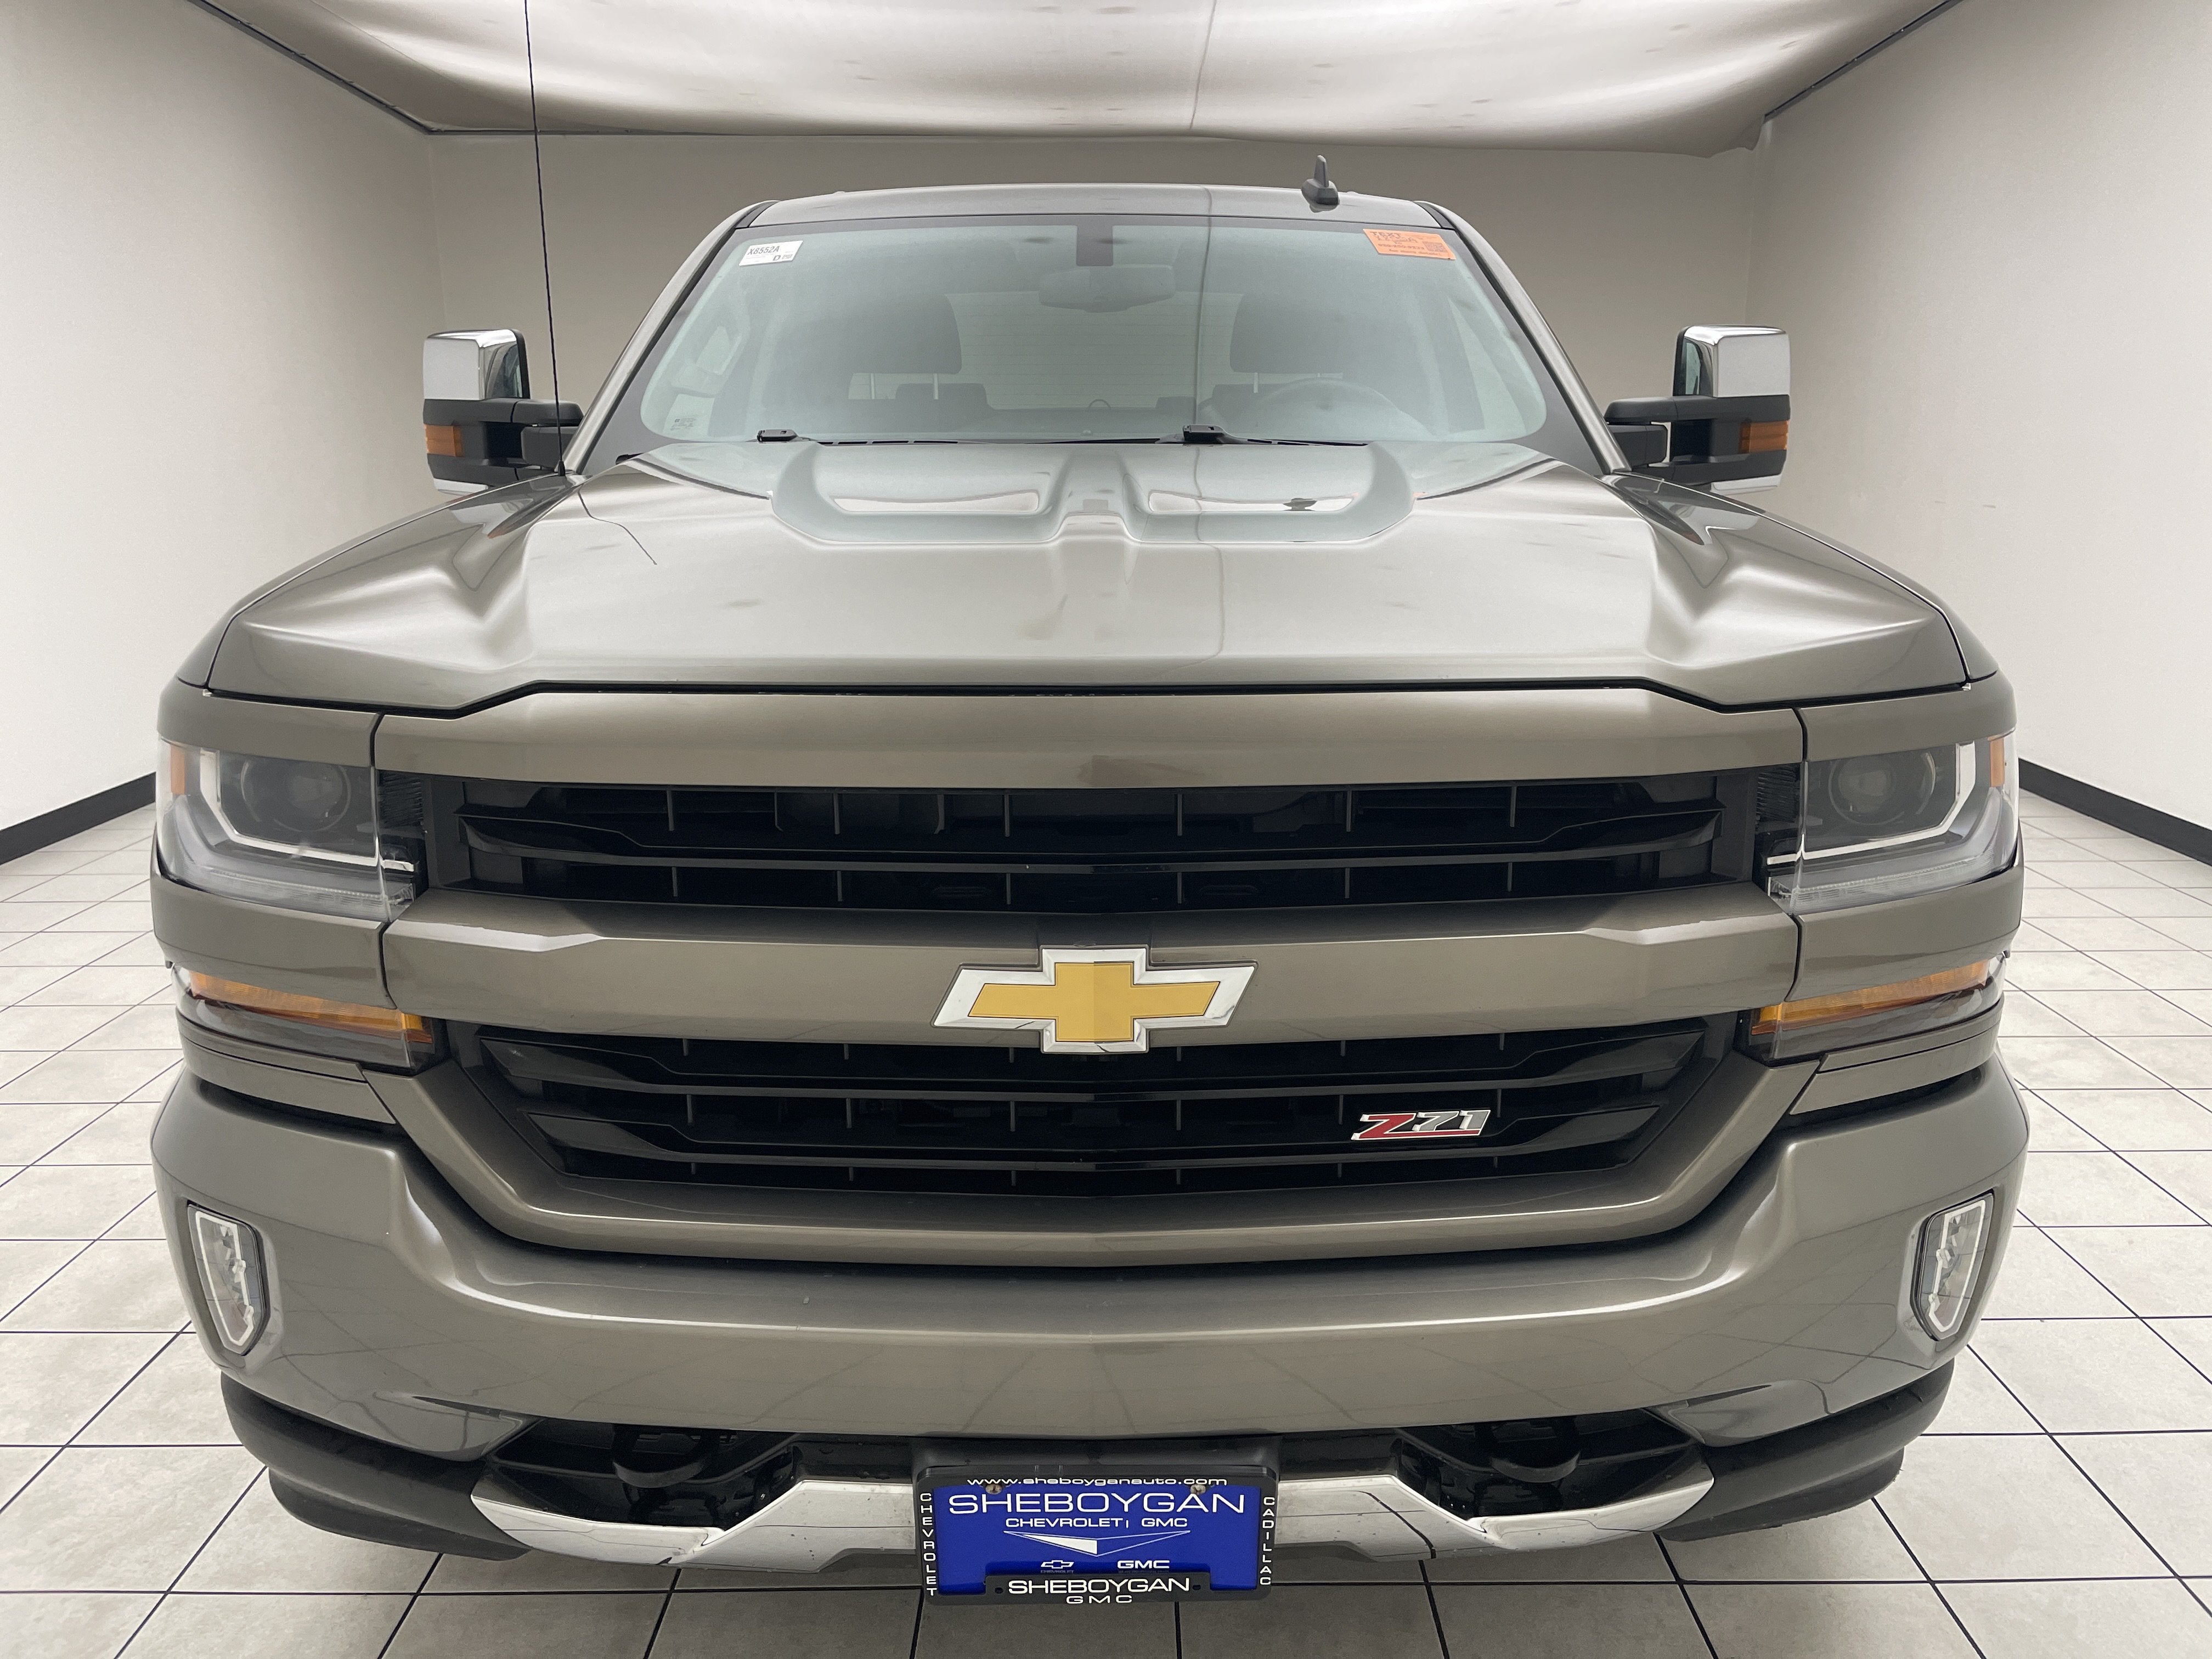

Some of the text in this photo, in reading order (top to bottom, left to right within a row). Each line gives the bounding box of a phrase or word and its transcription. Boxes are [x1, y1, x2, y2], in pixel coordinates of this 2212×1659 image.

[747, 246, 780, 255] X8552A
[1351, 1109, 1491, 1141] Z71
[967, 1477, 1227, 1486] www.sheboyganauto.com
[949, 1492, 1244, 1514] SHEBOYGAN
[1006, 1517, 1188, 1527] CHEVROLET GMC
[920, 1493, 938, 1596] CHEVROLET
[1260, 1497, 1275, 1585] CADILLAC
[1118, 1560, 1170, 1569] GMC
[1008, 1577, 1190, 1594] SHEBOYGAN
[1066, 1595, 1132, 1604] GMC
